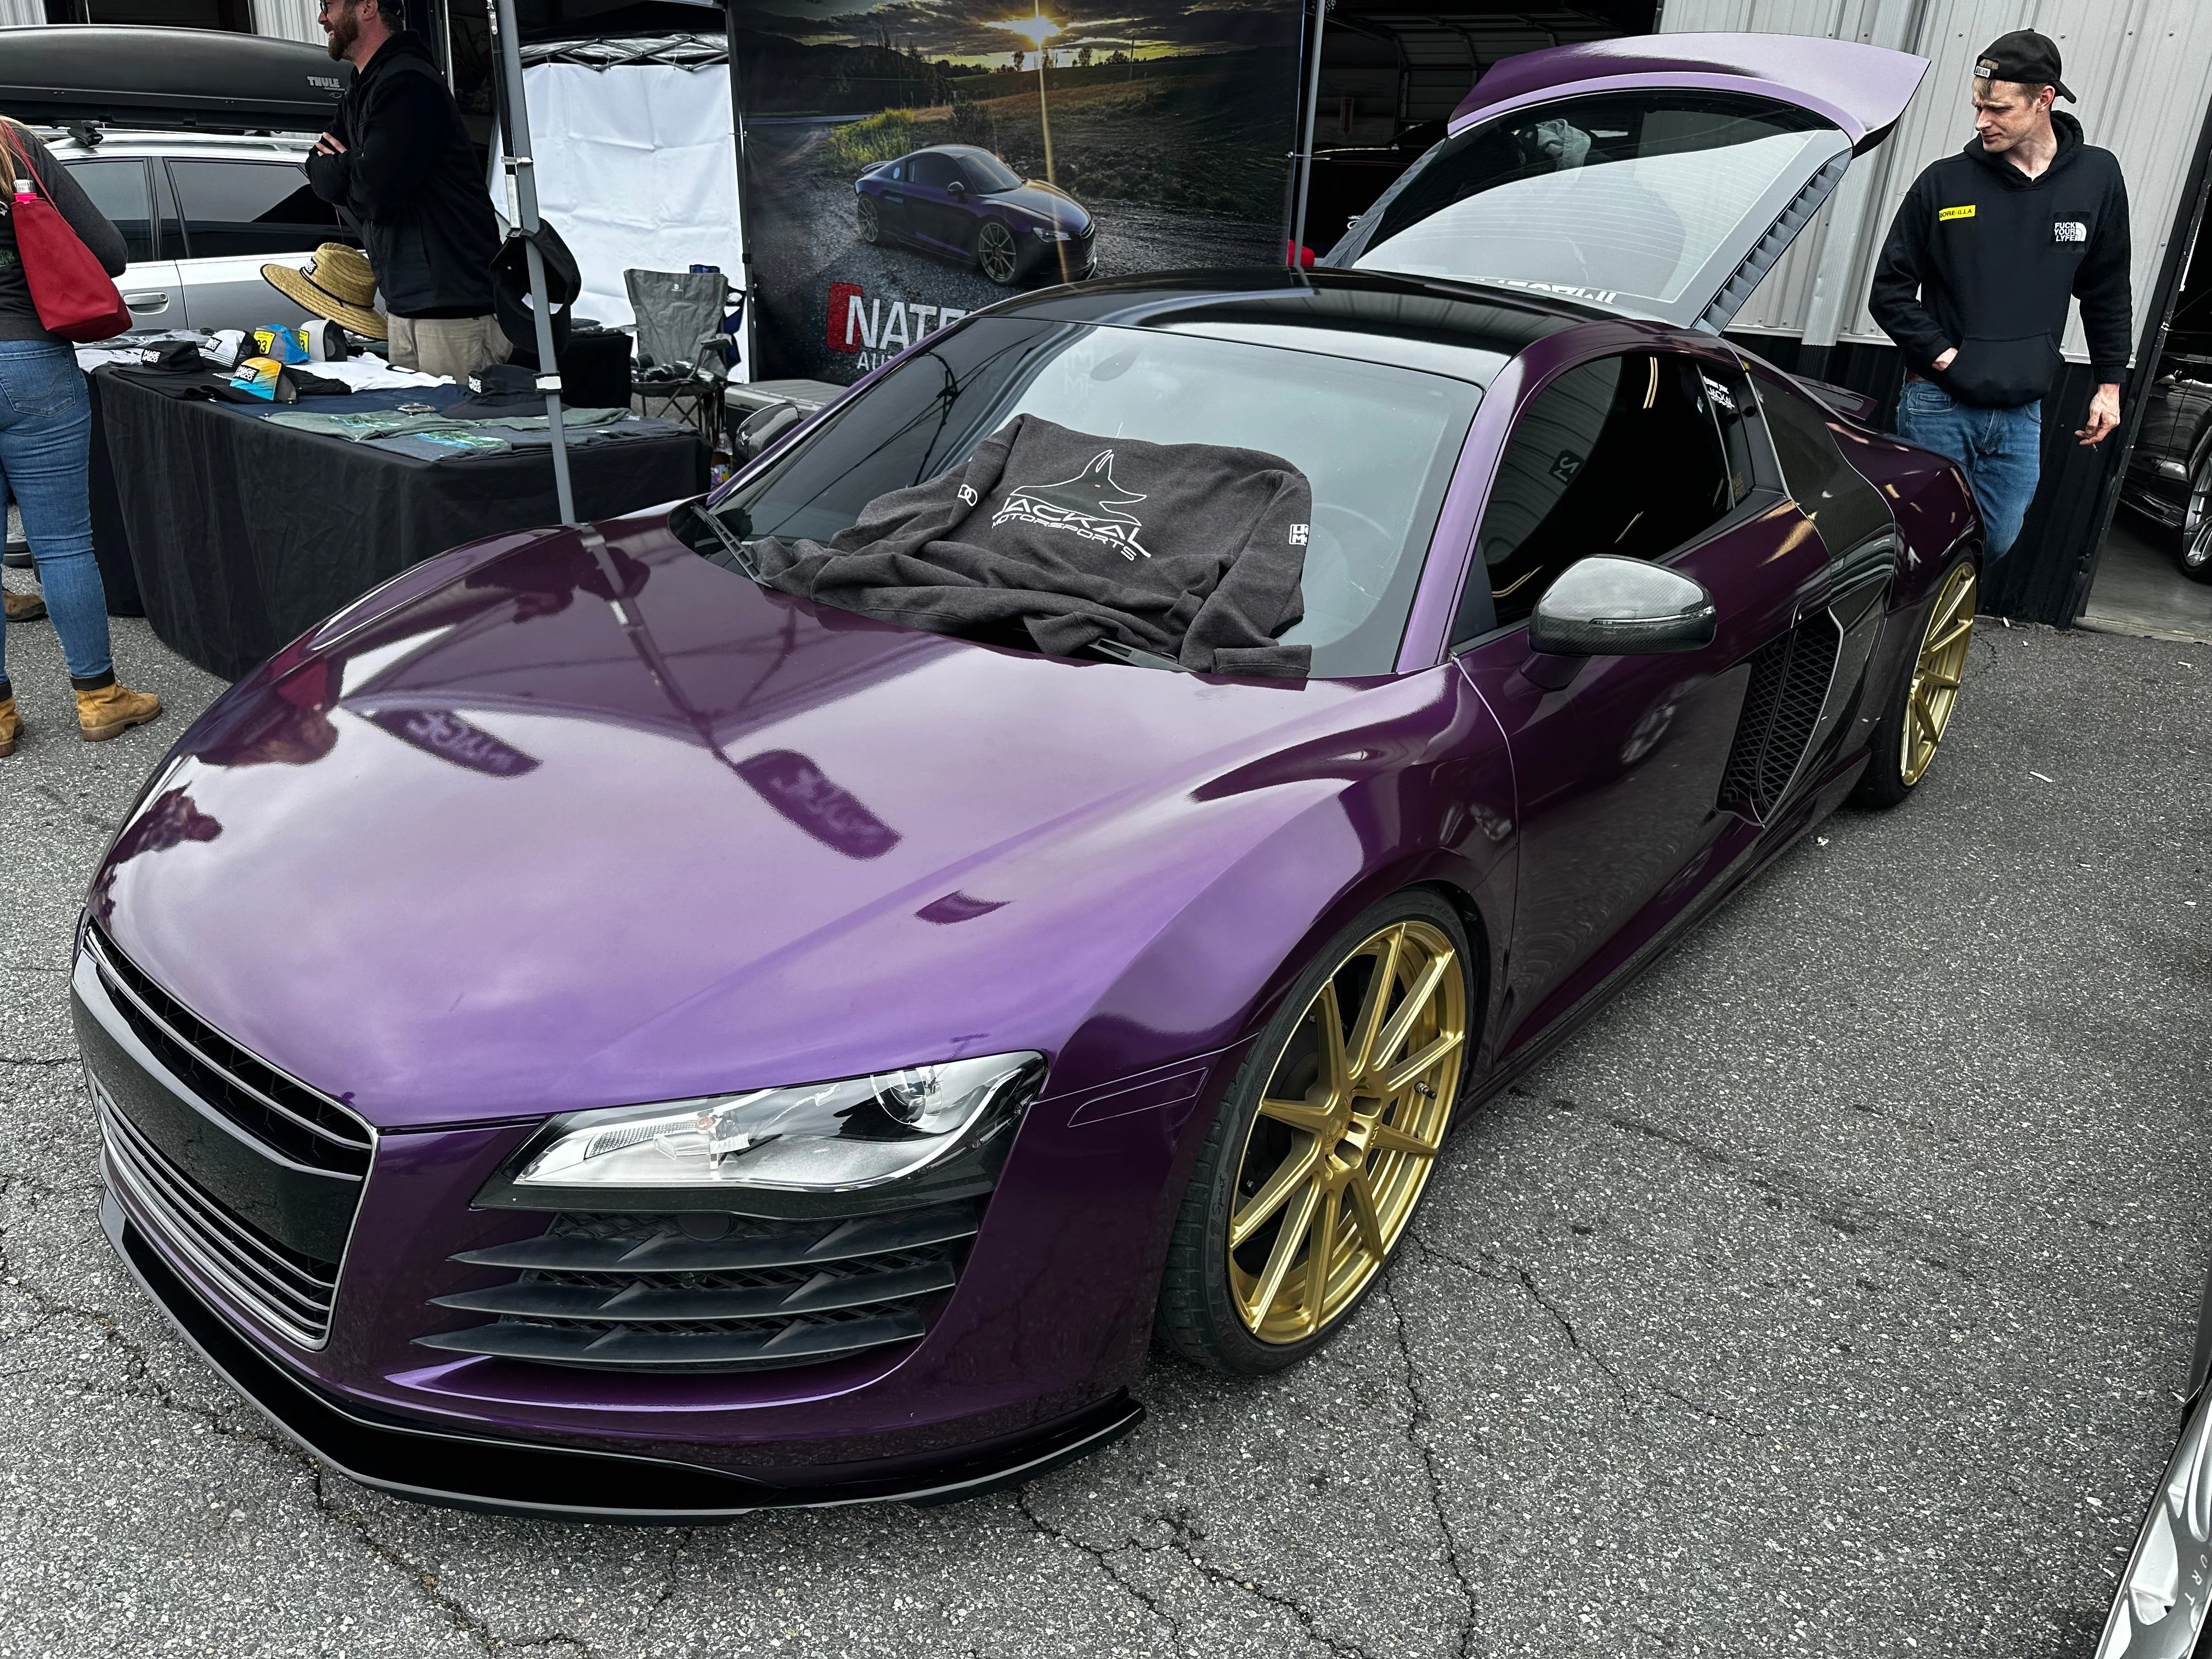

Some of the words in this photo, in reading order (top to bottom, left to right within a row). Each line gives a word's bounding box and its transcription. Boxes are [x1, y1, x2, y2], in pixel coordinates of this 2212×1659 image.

[307, 76, 340, 87] THULE
[991, 513, 1137, 561] MOTORSPORTS
[992, 497, 1152, 558] JACKAL
